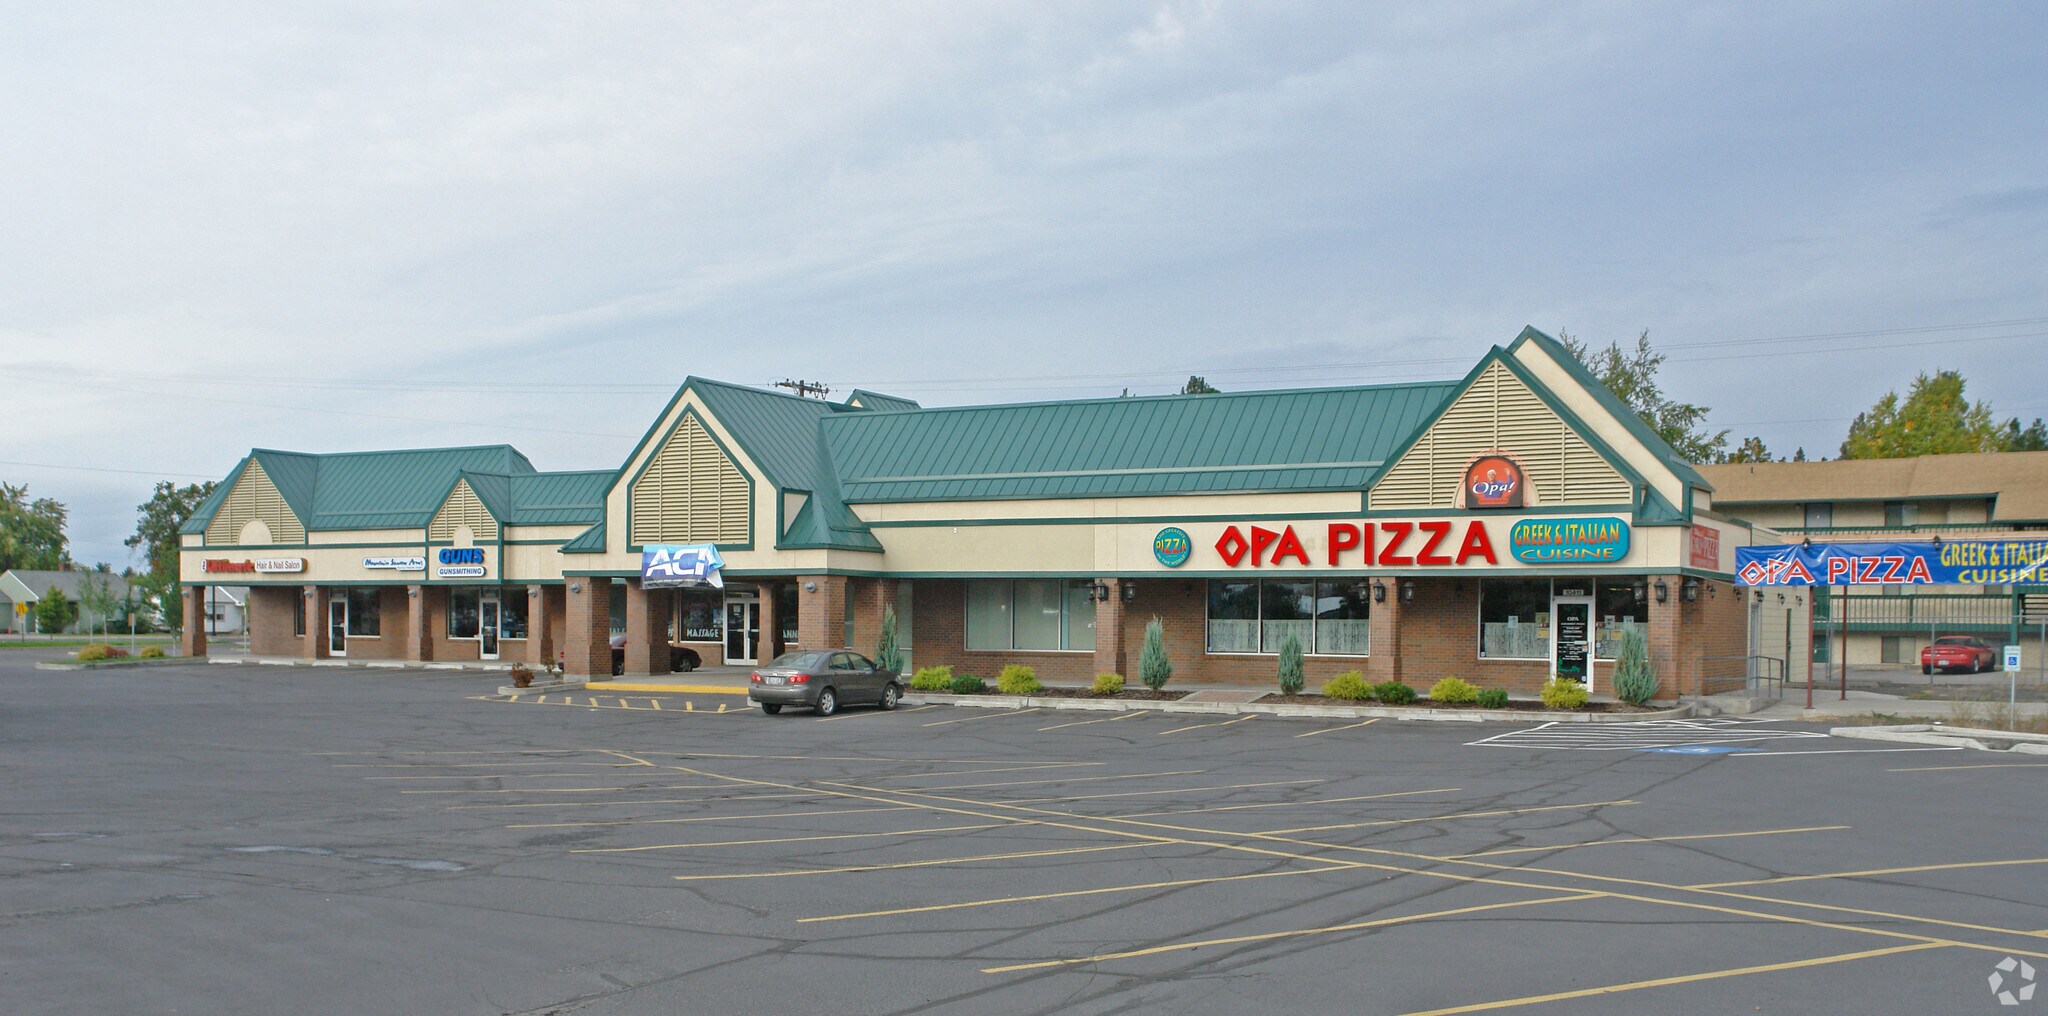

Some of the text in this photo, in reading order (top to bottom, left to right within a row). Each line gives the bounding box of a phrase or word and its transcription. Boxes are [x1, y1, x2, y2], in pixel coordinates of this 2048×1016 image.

[1472, 481, 1516, 496] Opa!
[1514, 522, 1619, 546] GREEK & ITALIAN
[1156, 538, 1187, 554] PIZZA
[1214, 520, 1498, 567] OPA PIZZA
[439, 548, 483, 564] GUNS
[1520, 547, 1614, 560] CUISINE
[1941, 543, 1987, 566] GREEK
[1990, 543, 2000, 566] &
[439, 567, 482, 575] GUNSMITHING
[1739, 555, 1932, 585] OPA PIZZA
[1957, 568, 2048, 584] CUISINE
[686, 628, 719, 638] MASSAGE
